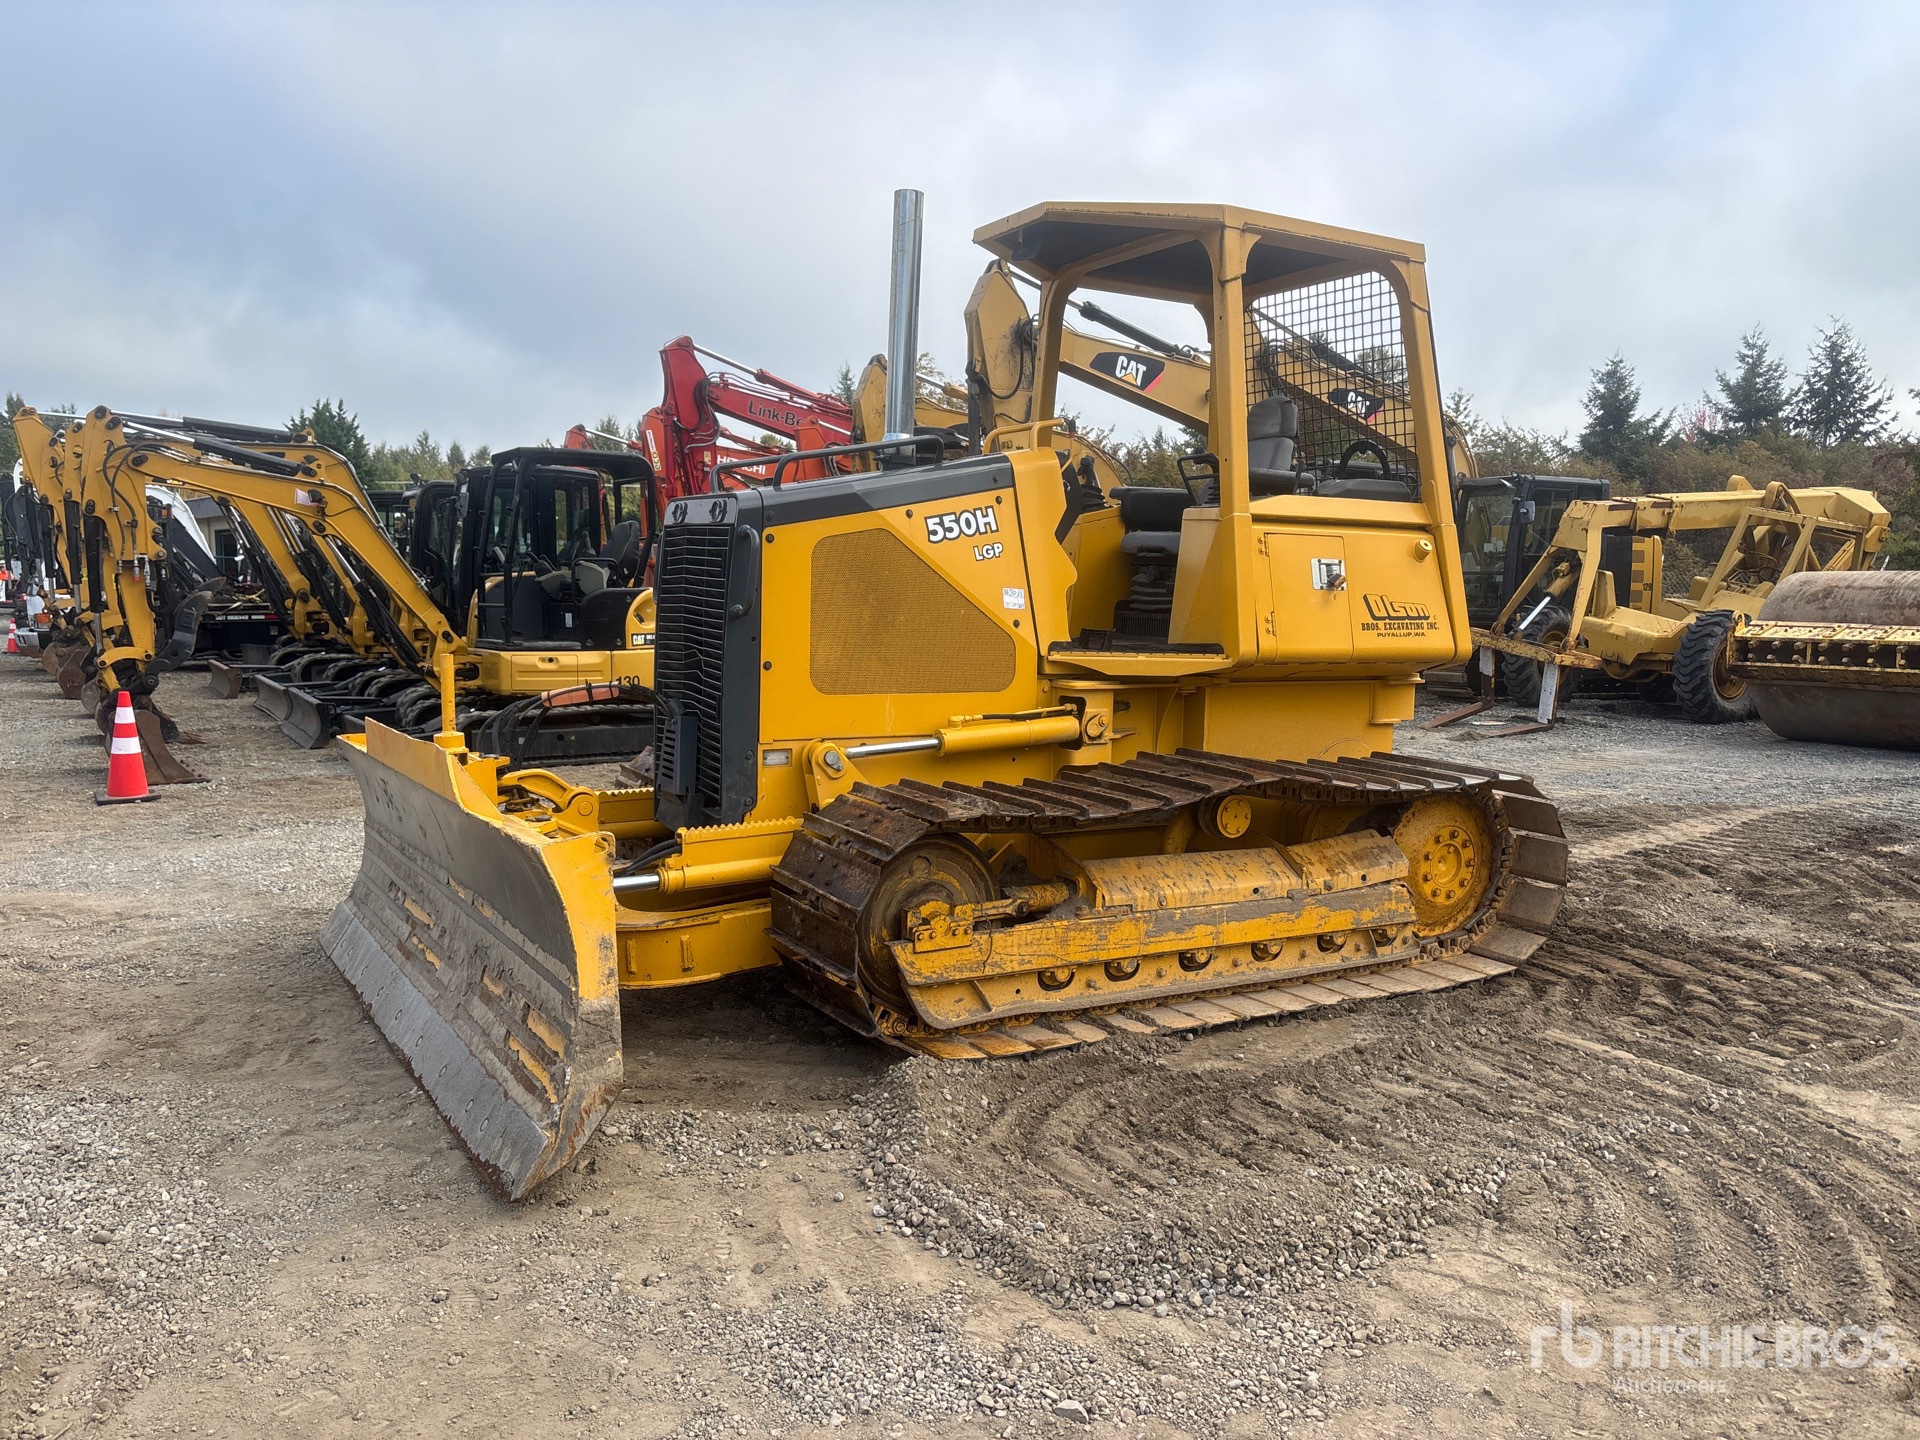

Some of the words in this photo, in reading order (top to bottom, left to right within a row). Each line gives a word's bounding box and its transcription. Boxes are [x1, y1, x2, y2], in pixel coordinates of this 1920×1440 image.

[1115, 355, 1147, 387] CAT
[748, 400, 805, 427] Link-Be
[924, 505, 999, 544] 550H
[973, 541, 1004, 561] LGP
[1361, 622, 1382, 631] BROS.
[1383, 621, 1425, 631] EXCAVATING
[1426, 621, 1440, 631] INC.
[632, 634, 646, 645] CAT
[616, 675, 641, 686] 130
